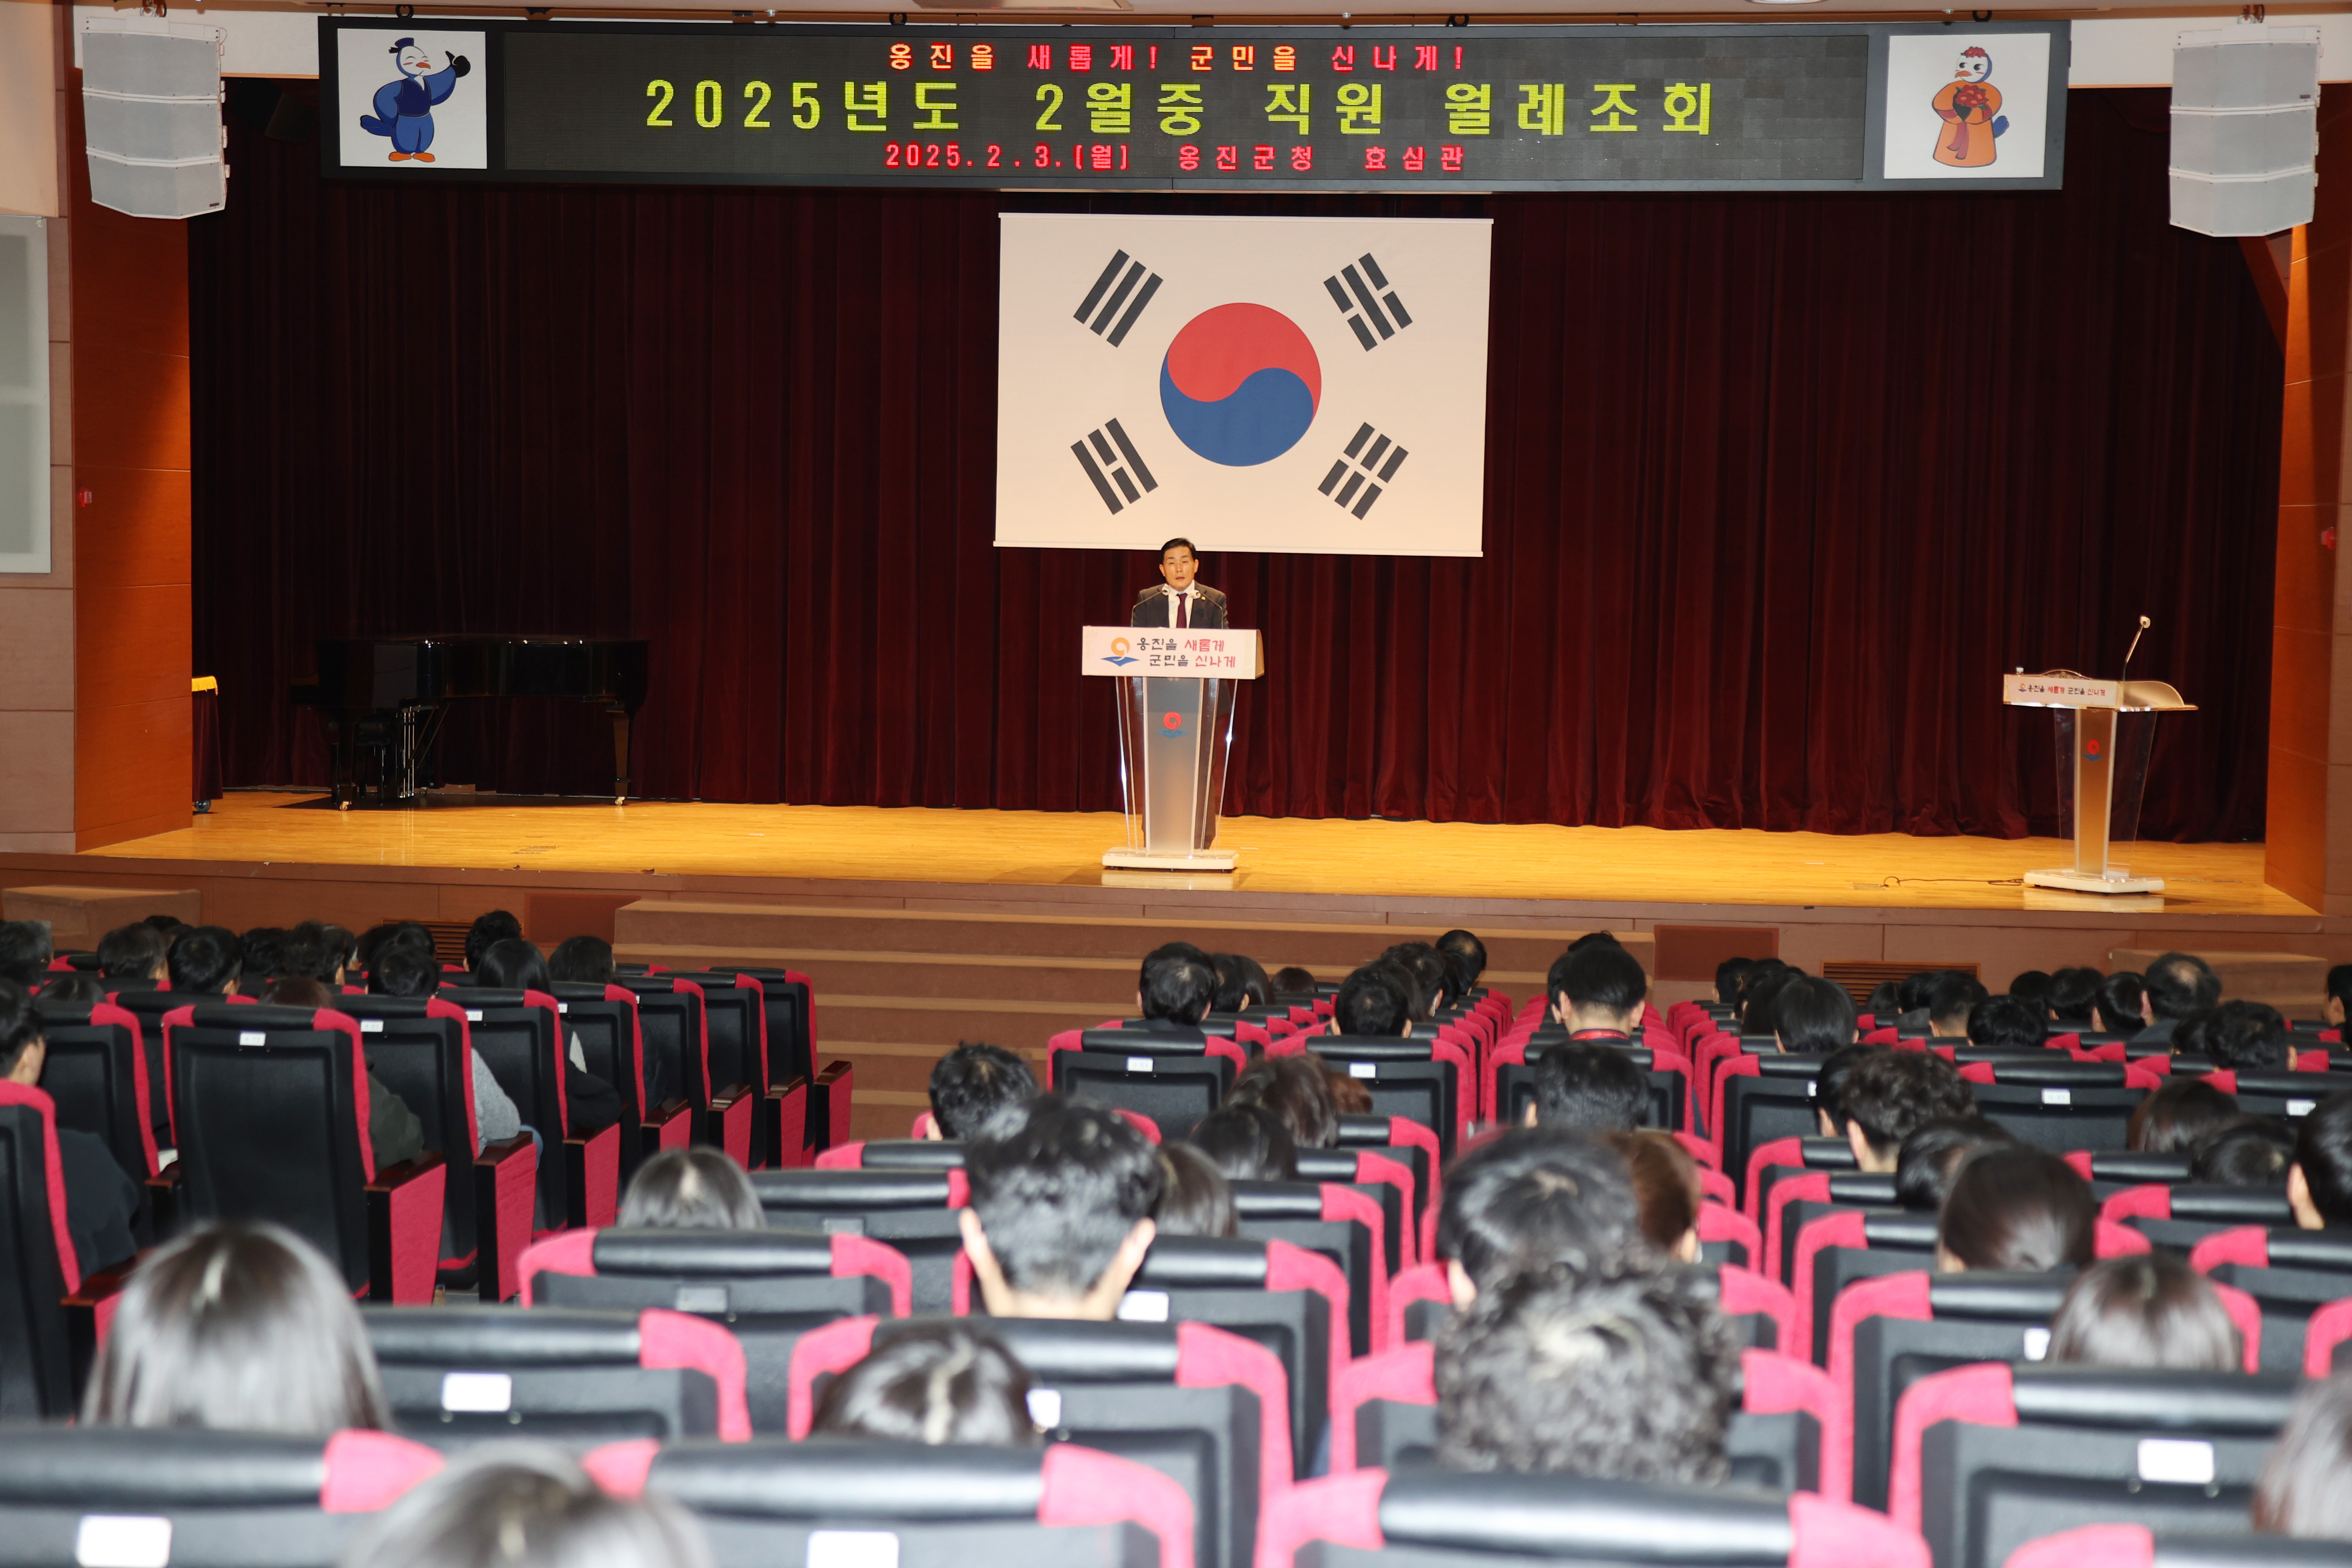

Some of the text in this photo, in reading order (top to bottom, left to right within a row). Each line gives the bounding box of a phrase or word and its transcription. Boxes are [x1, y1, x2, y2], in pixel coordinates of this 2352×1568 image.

[889, 43, 1464, 72] 옹진을 새롭게! 군민을 신나게!
[647, 80, 1711, 136] 2025년도 2월중 직원 월례조회
[1178, 144, 1313, 172] 옹진군청
[1364, 145, 1464, 172] 효심관
[1137, 637, 1224, 652] 옹진을 새롭게
[1149, 654, 1236, 668] 군민을 신나게
[2048, 686, 2065, 694] 새롭게
